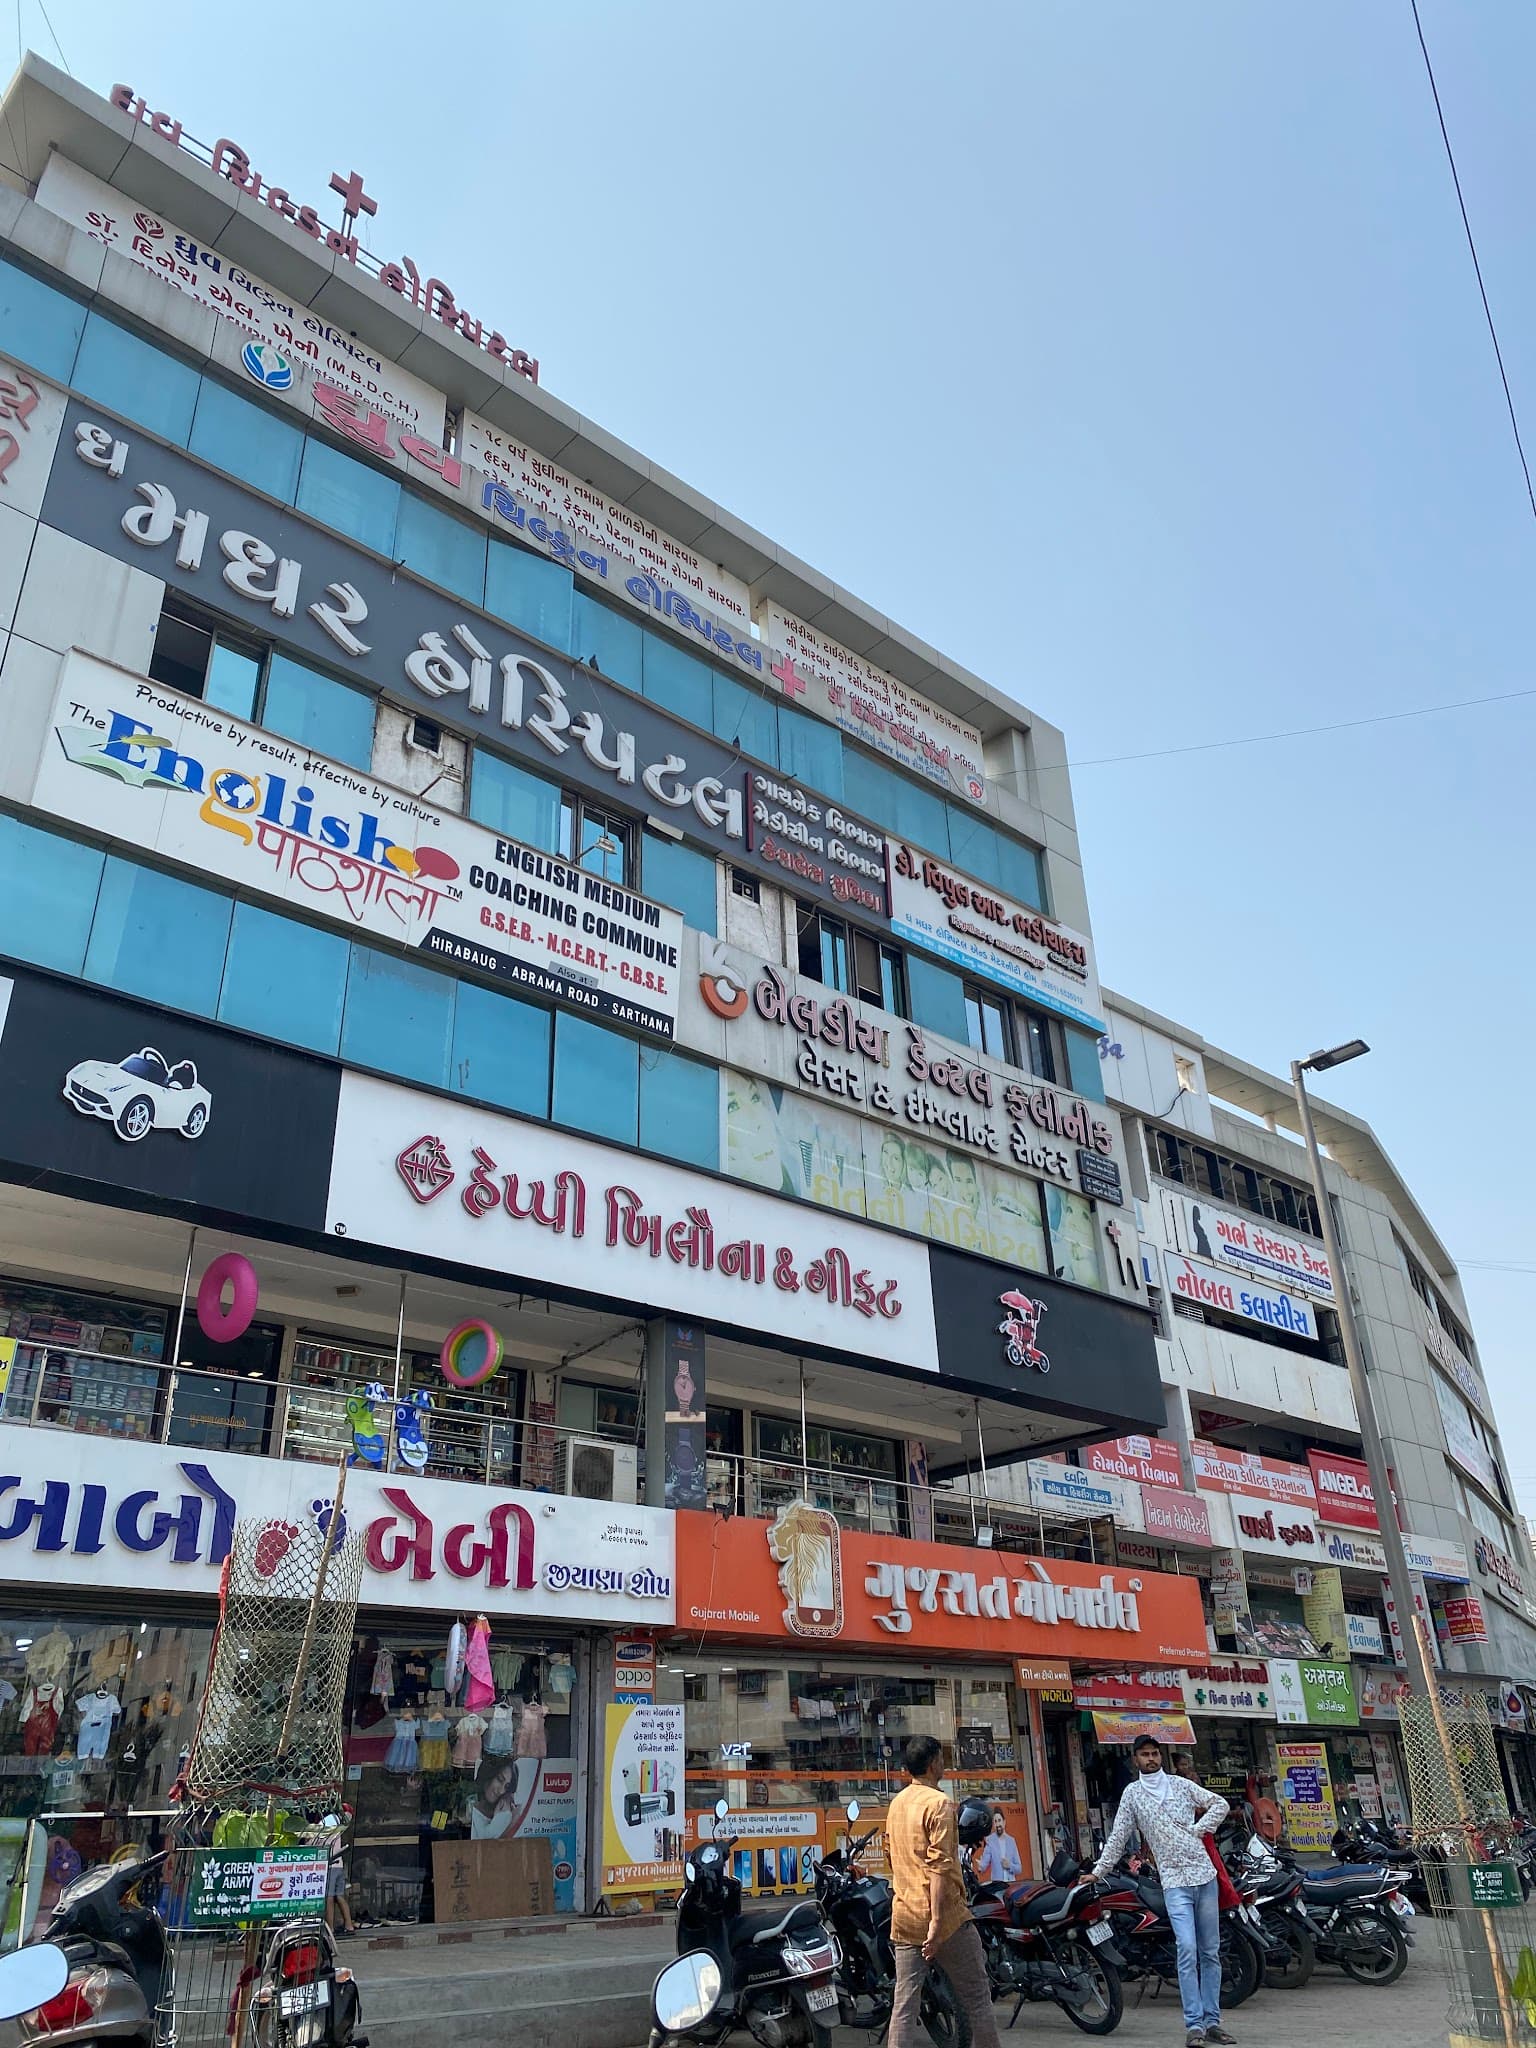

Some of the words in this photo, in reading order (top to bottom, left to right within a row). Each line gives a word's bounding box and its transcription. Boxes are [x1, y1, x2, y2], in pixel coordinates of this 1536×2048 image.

[132, 235, 197, 286] દિનેશ
[208, 284, 260, 324] એલ.
[327, 357, 419, 421] (M.B.D.C.H.)
[303, 310, 382, 374] હોસ્પિટલ
[380, 255, 539, 385] હોસ્પિટલ
[508, 443, 527, 462] વર્ષ
[532, 458, 568, 489] સુધીના
[575, 483, 604, 510] તમામ
[609, 503, 658, 544] બાળકોની
[663, 536, 699, 569] સારવાર
[521, 473, 556, 503] મગજ,
[606, 520, 634, 549] પેટના
[639, 544, 667, 570] તમામ
[672, 560, 703, 591] રોગની
[74, 421, 129, 479] ધ
[120, 481, 371, 657] મધર
[404, 624, 743, 839] હોસ્પિટલ
[625, 574, 762, 671] હોસ્પિટલ
[786, 636, 797, 650] ની
[800, 646, 831, 670] સારવાર
[895, 701, 918, 725] સુવિધા
[69, 701, 106, 730] The
[891, 680, 907, 701] જેવા
[910, 696, 930, 715] તમામ
[963, 728, 978, 745] તાવ
[136, 684, 222, 734] Productive
[227, 721, 246, 747] by
[303, 761, 367, 795] effective
[372, 785, 389, 811] by
[393, 798, 441, 827] culture
[99, 709, 408, 873] English
[754, 775, 821, 822] ગાયનેક
[825, 807, 883, 853] વિભાગ
[753, 800, 823, 853] મેડીસીન
[828, 839, 886, 883] વિભાગ
[255, 820, 460, 924] पाठशाला
[446, 885, 463, 900] TM
[495, 839, 580, 893] ENGLISH
[584, 877, 660, 928] MEDIUM
[923, 859, 970, 909] વિપુલ
[469, 865, 577, 927] COACHING
[583, 911, 677, 968] COMMUNE
[936, 928, 968, 950] હોસ્પિટલ
[480, 906, 534, 944] G.S.E.B.
[548, 932, 609, 973] N.C.E.R.T.
[620, 962, 668, 995] C.B.S.E.
[557, 966, 576, 980] Also
[431, 935, 497, 969] HIRABAUG
[512, 966, 562, 994] ABRAMA
[568, 985, 599, 1007] ROAD
[612, 1003, 670, 1033] SARTHANA
[797, 1039, 863, 1101] લેસર
[872, 1082, 898, 1114] &
[1010, 1122, 1073, 1181] સેન્ટર
[774, 1246, 801, 1293] &
[1217, 1219, 1249, 1249] ગર્ભ
[1253, 1229, 1299, 1266] સંસ્કાર
[1300, 1244, 1331, 1278] કેન્દ્ર
[1177, 1260, 1235, 1310] નોબલ
[1093, 1450, 1137, 1477] હોમલોન
[1140, 1461, 1179, 1486] વિભાગ
[1239, 1465, 1269, 1487] કેપીટલ
[1318, 1469, 1361, 1498] ANGEL
[0, 1462, 236, 1564] બાબો
[365, 1487, 537, 1591] બેબી
[1146, 1498, 1172, 1528] નિદાન
[1173, 1504, 1210, 1536] લેબોરેટરી
[1329, 1535, 1354, 1562] નીલ
[631, 1567, 670, 1595] શોપ
[864, 1561, 1012, 1634] ગુજરાત
[1013, 1561, 1141, 1633] મોબાઈલ
[690, 1606, 725, 1622] Gujarat
[729, 1609, 760, 1623] Mobile
[1159, 1646, 1185, 1656] Preferred
[1187, 1649, 1207, 1658] Partner
[617, 1671, 651, 1685] oppo
[620, 1694, 648, 1705] vivo
[1041, 1689, 1073, 1703] WORLD
[1304, 1666, 1350, 1695] અમૃતમ્
[546, 1777, 570, 1789] LuvLap
[1205, 1774, 1232, 1786] Jonny
[222, 1861, 255, 1875] GREEN
[222, 1876, 254, 1889] ARMY
[615, 1865, 648, 1883] ગુજરાત
[649, 1862, 681, 1876] મોબાઈલ
[1484, 1871, 1503, 1880] GREEN
